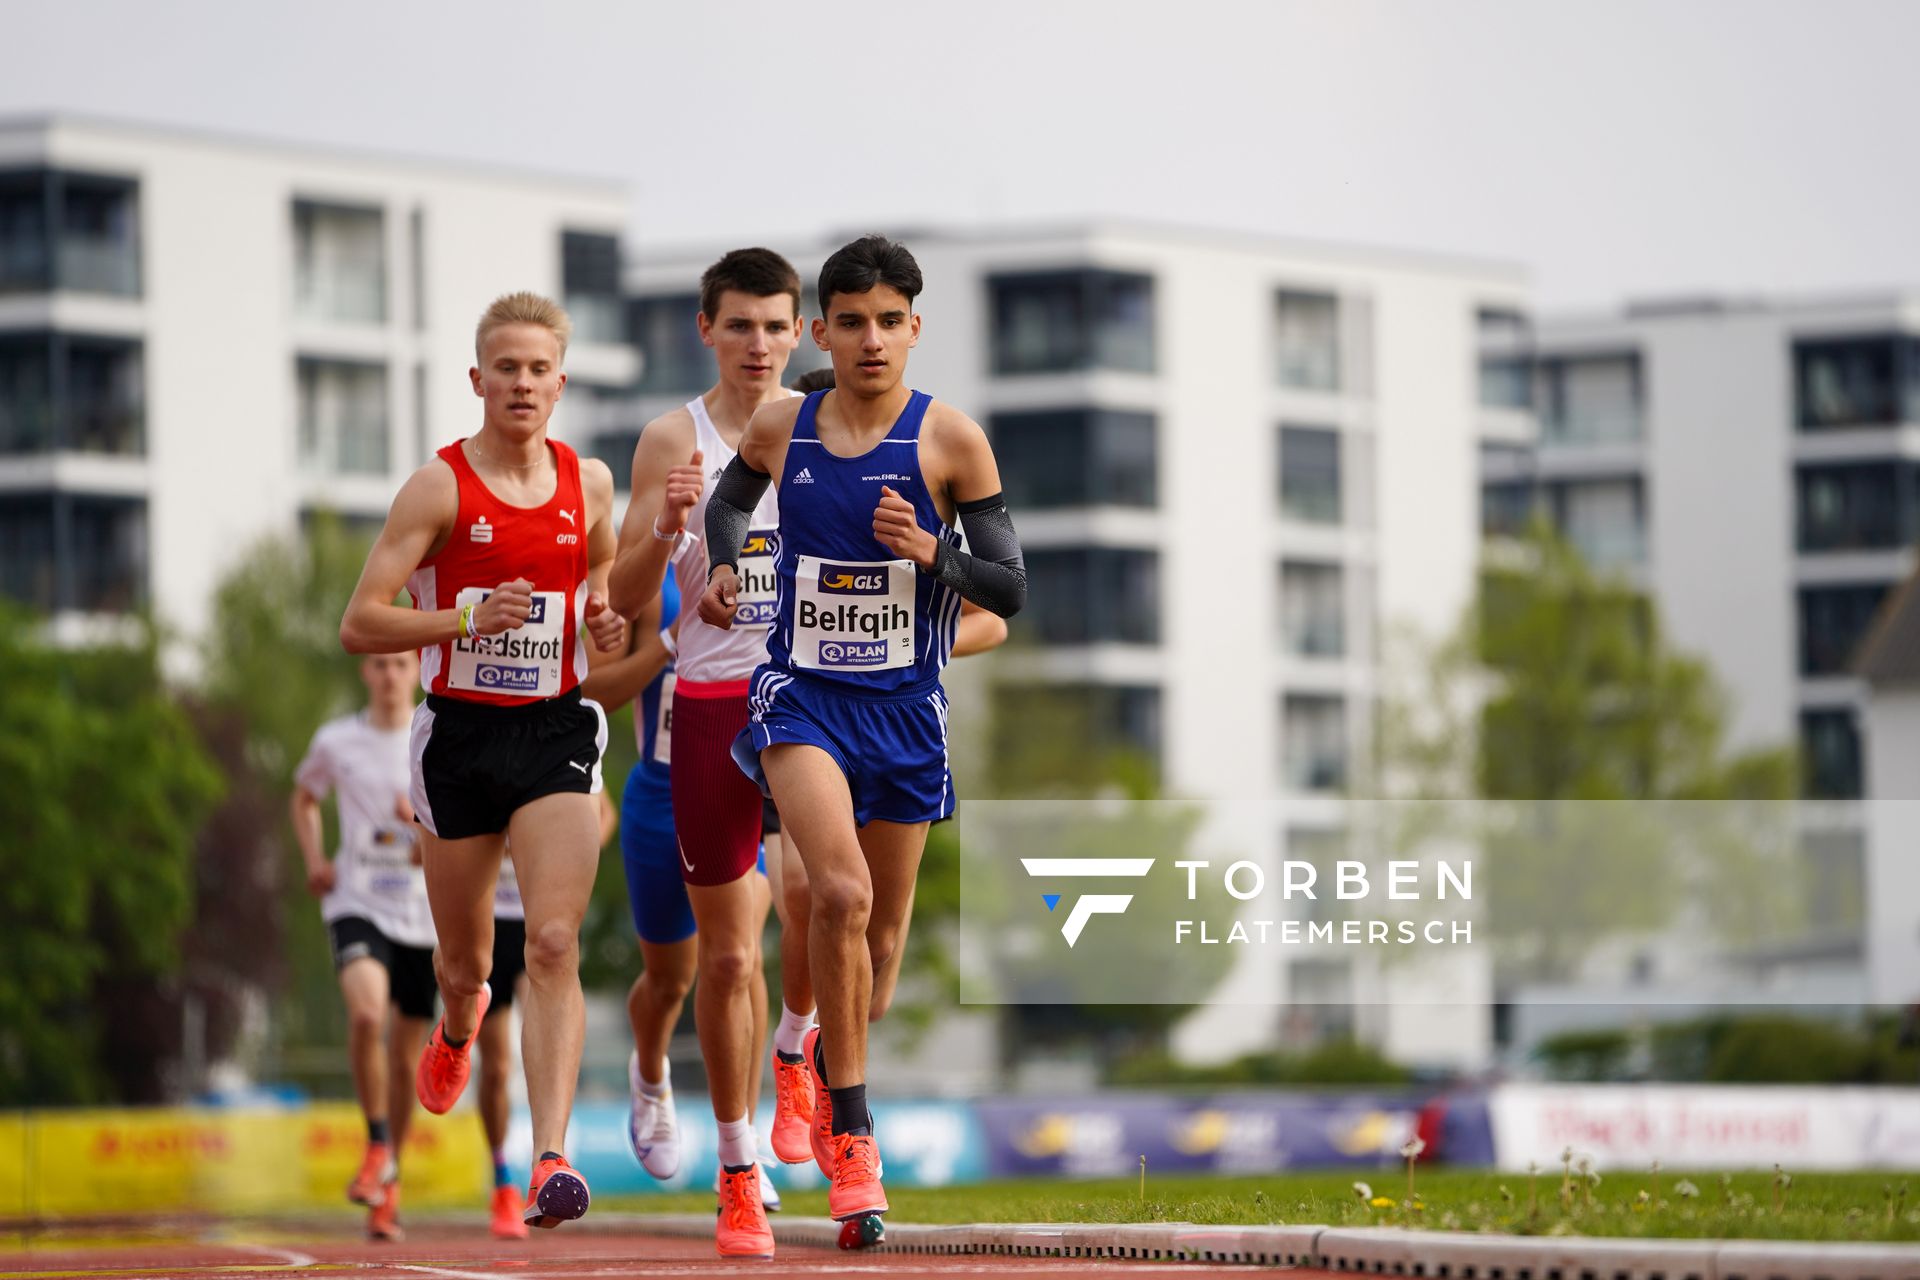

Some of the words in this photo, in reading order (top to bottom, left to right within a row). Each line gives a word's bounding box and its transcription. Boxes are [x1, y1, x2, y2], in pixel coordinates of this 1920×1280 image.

[861, 474, 911, 482] www.EHRL.eu
[854, 575, 884, 590] GLS
[799, 600, 909, 639] Belfqih
[846, 644, 885, 657] PLAN
[502, 670, 537, 682] PLAN
